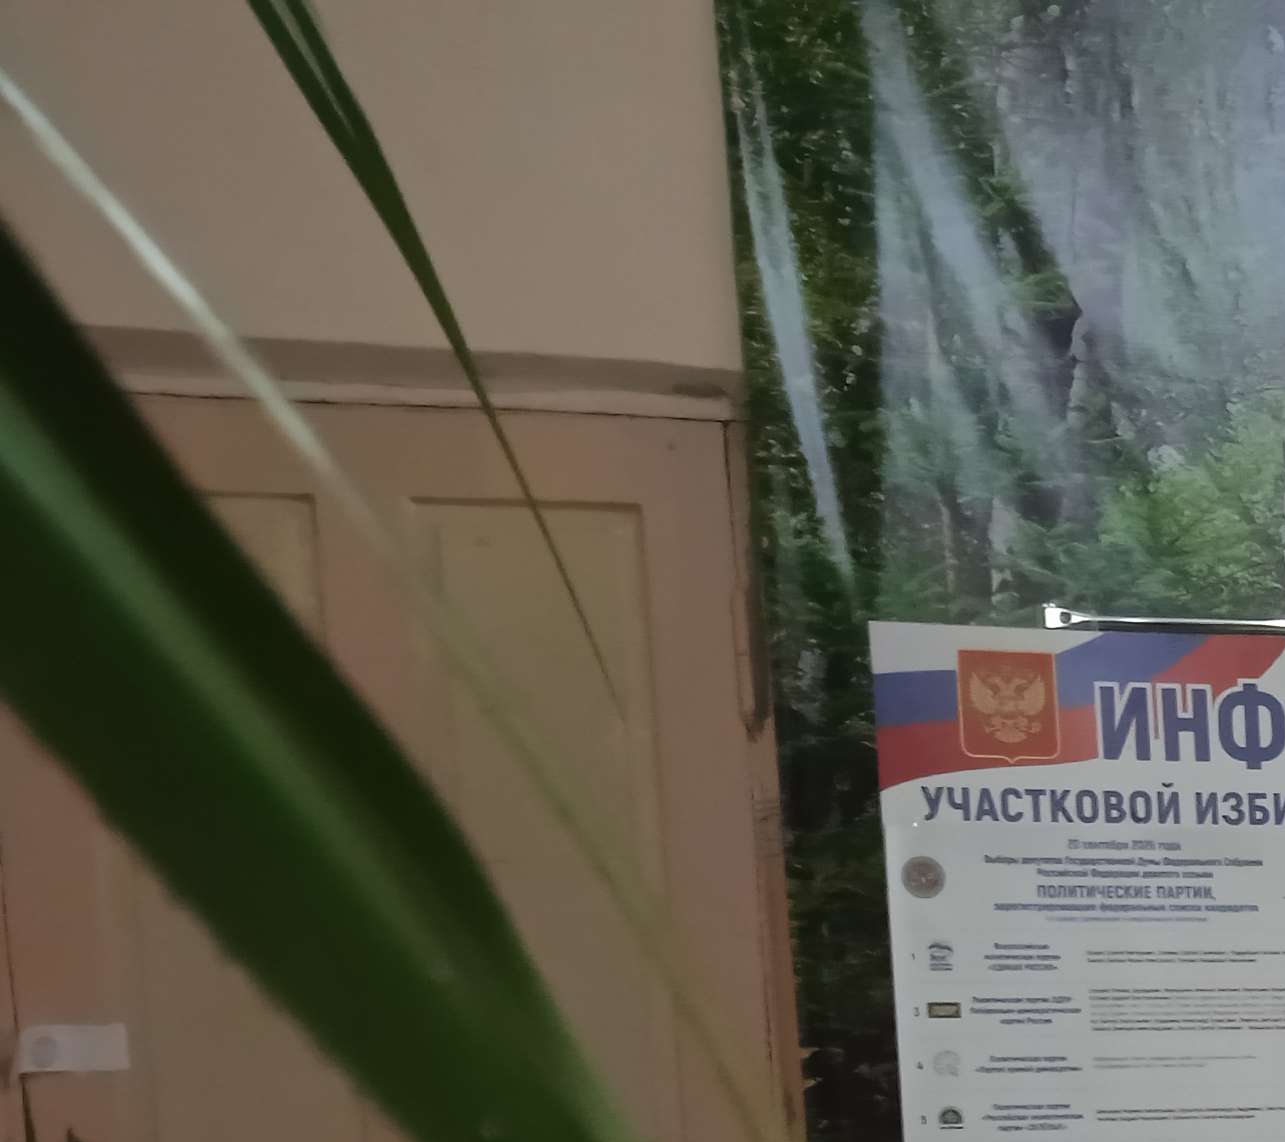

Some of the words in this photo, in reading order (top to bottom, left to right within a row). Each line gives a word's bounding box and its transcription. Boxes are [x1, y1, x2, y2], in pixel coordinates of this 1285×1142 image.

[921, 782, 1182, 826] УЧАСТКОВОЙ
[1037, 884, 1152, 899] ПОЛИТИЧЕСКИЕ
[1155, 884, 1217, 901] ПАРТИИ,
